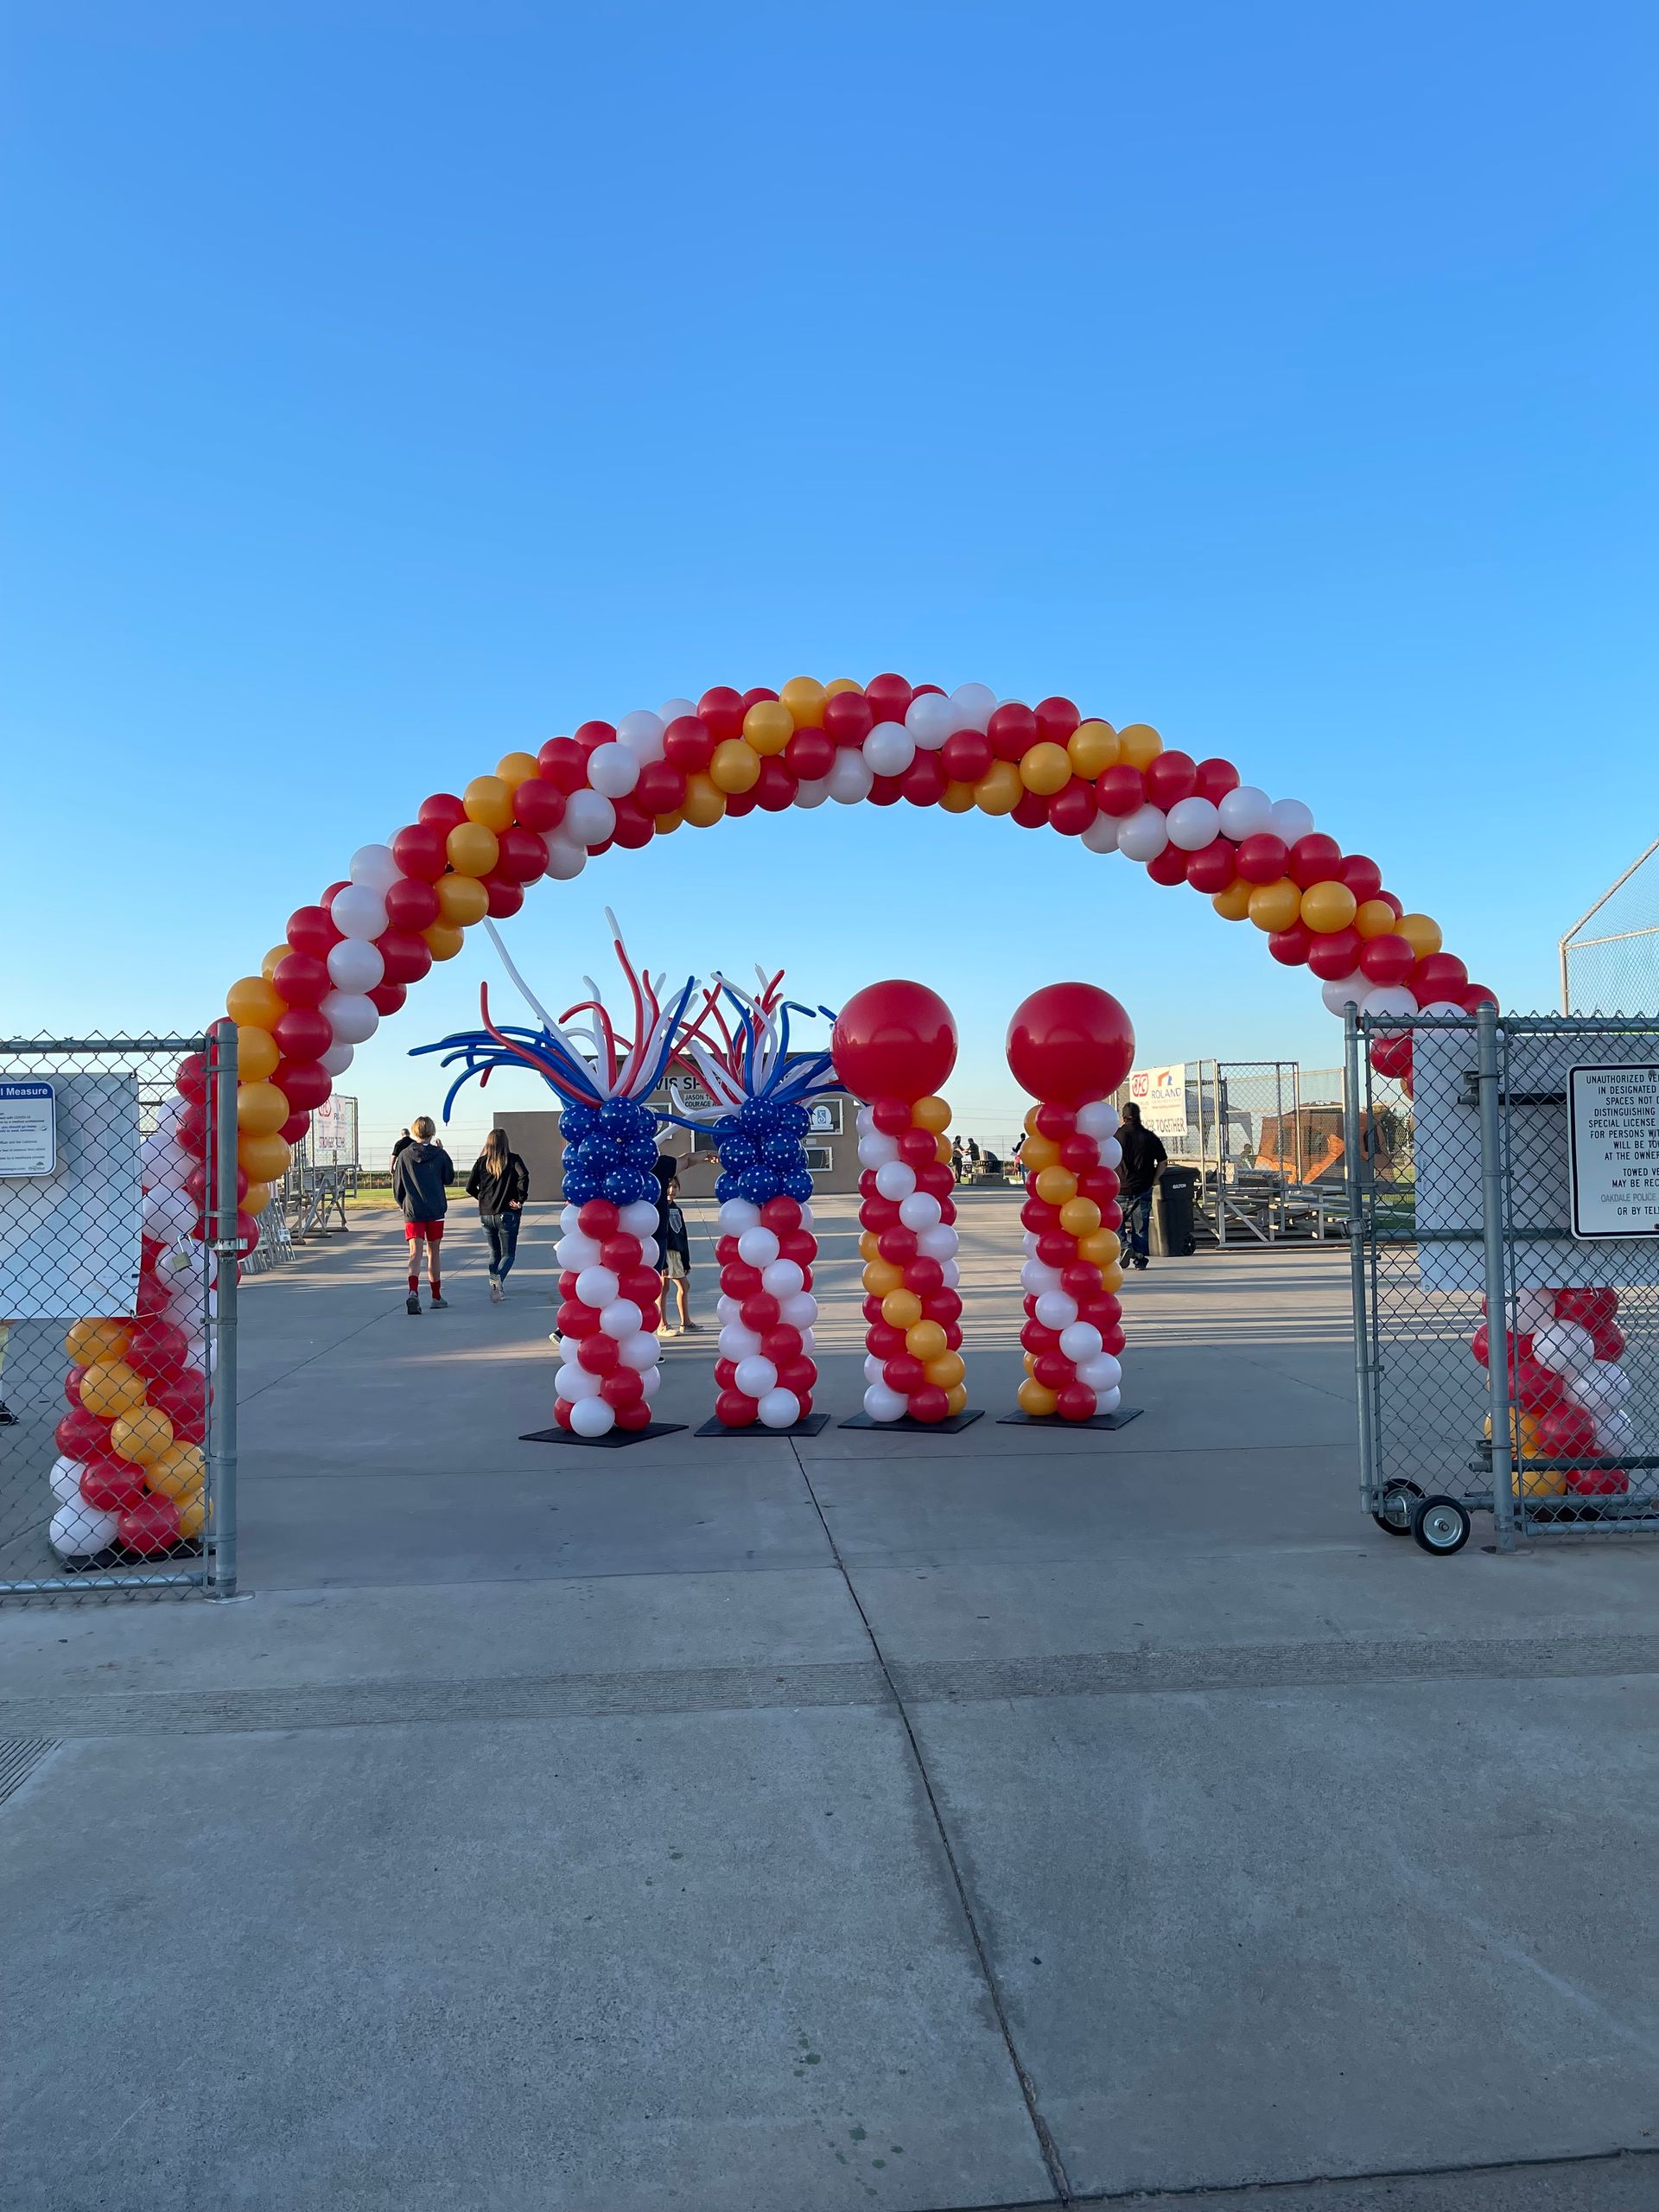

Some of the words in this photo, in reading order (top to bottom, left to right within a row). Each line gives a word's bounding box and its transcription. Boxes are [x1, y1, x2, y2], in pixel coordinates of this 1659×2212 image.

[1586, 1074, 1644, 1084] UNAUTHORIZED
[1648, 1074, 1659, 1083] VE
[6, 1087, 48, 1096] Measure
[1151, 1087, 1181, 1099] ROLAND
[1598, 1086, 1606, 1095] IN
[1610, 1084, 1656, 1095] DESIGNATED
[1605, 1096, 1635, 1106] SPACES
[1638, 1096, 1653, 1105] NOT
[1594, 1107, 1656, 1117] DISTINGUISHING
[1588, 1119, 1620, 1128] SPECIAL
[1623, 1118, 1656, 1128] LICENSE
[1590, 1130, 1605, 1139] FOR
[1609, 1129, 1644, 1139] PERSONS
[1613, 1141, 1631, 1149] WILL
[1634, 1141, 1644, 1149] BE
[1648, 1140, 1659, 1149] TO
[1604, 1152, 1613, 1160] AT
[1616, 1152, 1630, 1160] THE
[1623, 1168, 1649, 1177] TOWED
[1611, 1179, 1627, 1188] MAY
[1630, 1179, 1641, 1188] BE
[1600, 1193, 1631, 1203] OAKDALE
[1632, 1192, 1657, 1202] POLICE
[1617, 1206, 1628, 1216] OR
[1631, 1206, 1642, 1215] BY
